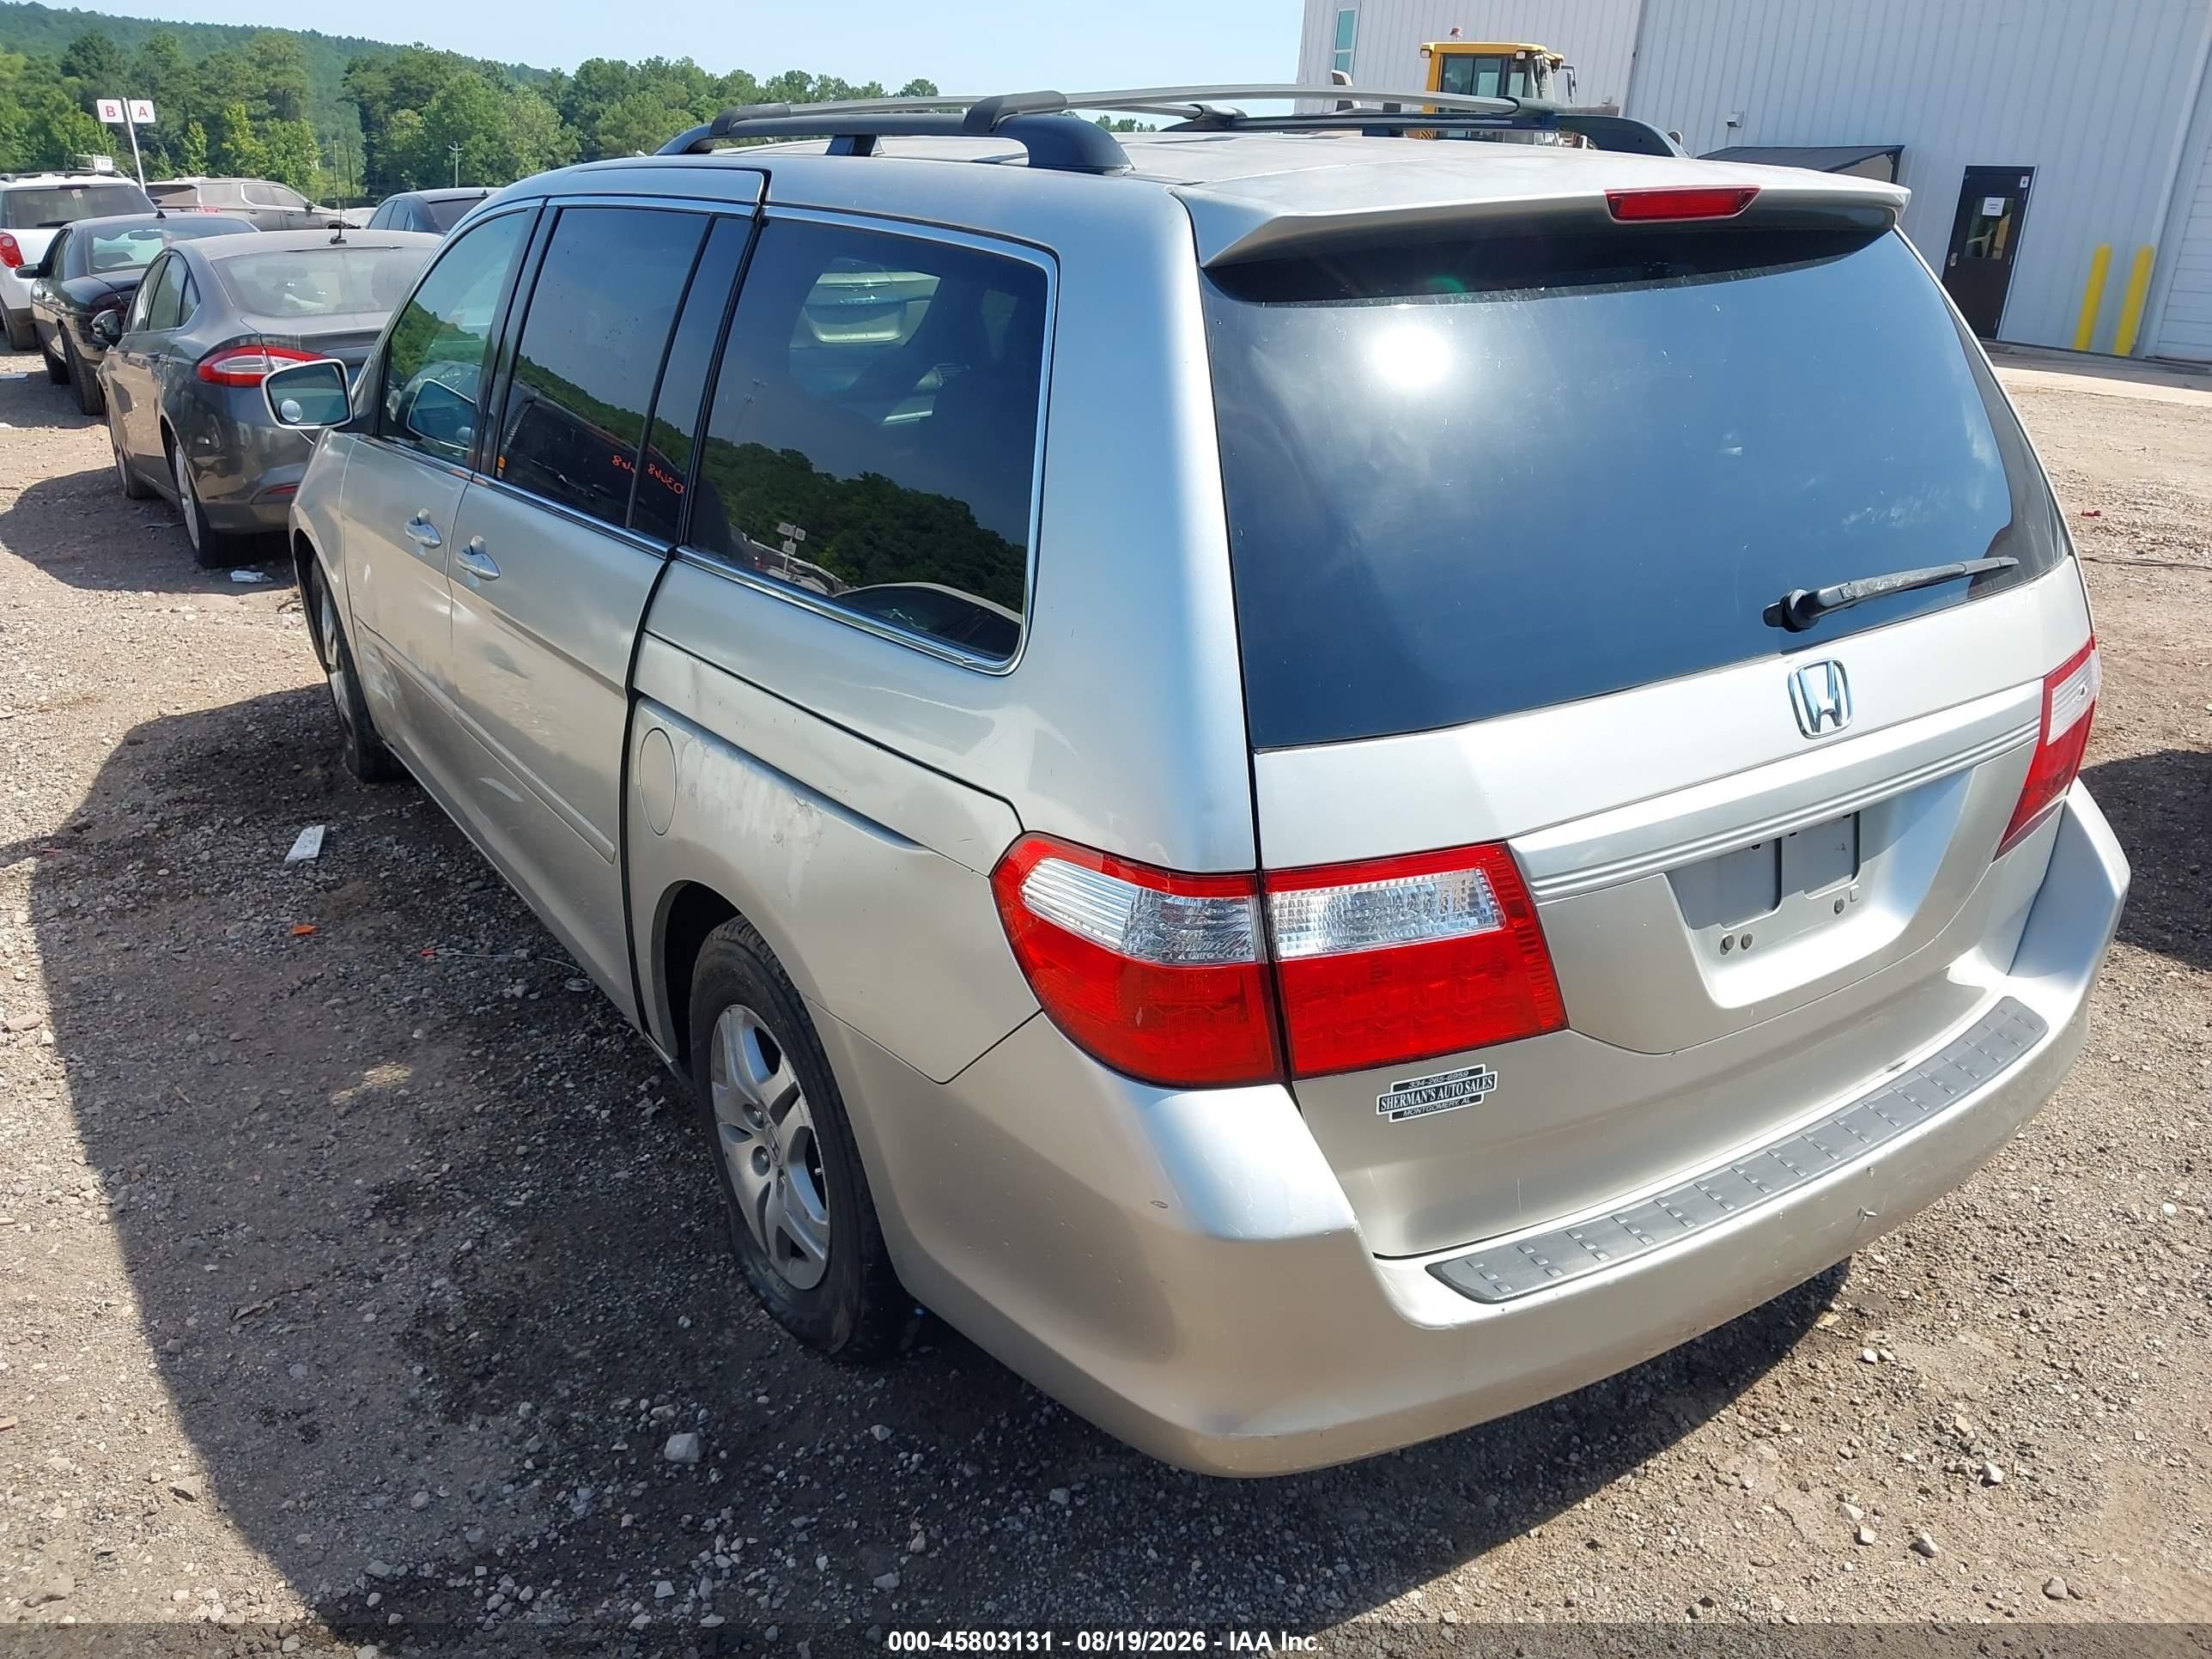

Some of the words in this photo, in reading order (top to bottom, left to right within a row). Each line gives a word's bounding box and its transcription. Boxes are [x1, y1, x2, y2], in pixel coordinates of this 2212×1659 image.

[105, 106, 116, 118] B
[138, 106, 149, 118] A
[1408, 1071, 1469, 1089] 334-265-6959
[1381, 1088, 1436, 1111] SHERMAN'S
[1437, 1082, 1463, 1100] AUTO
[1464, 1075, 1493, 1094] SALES
